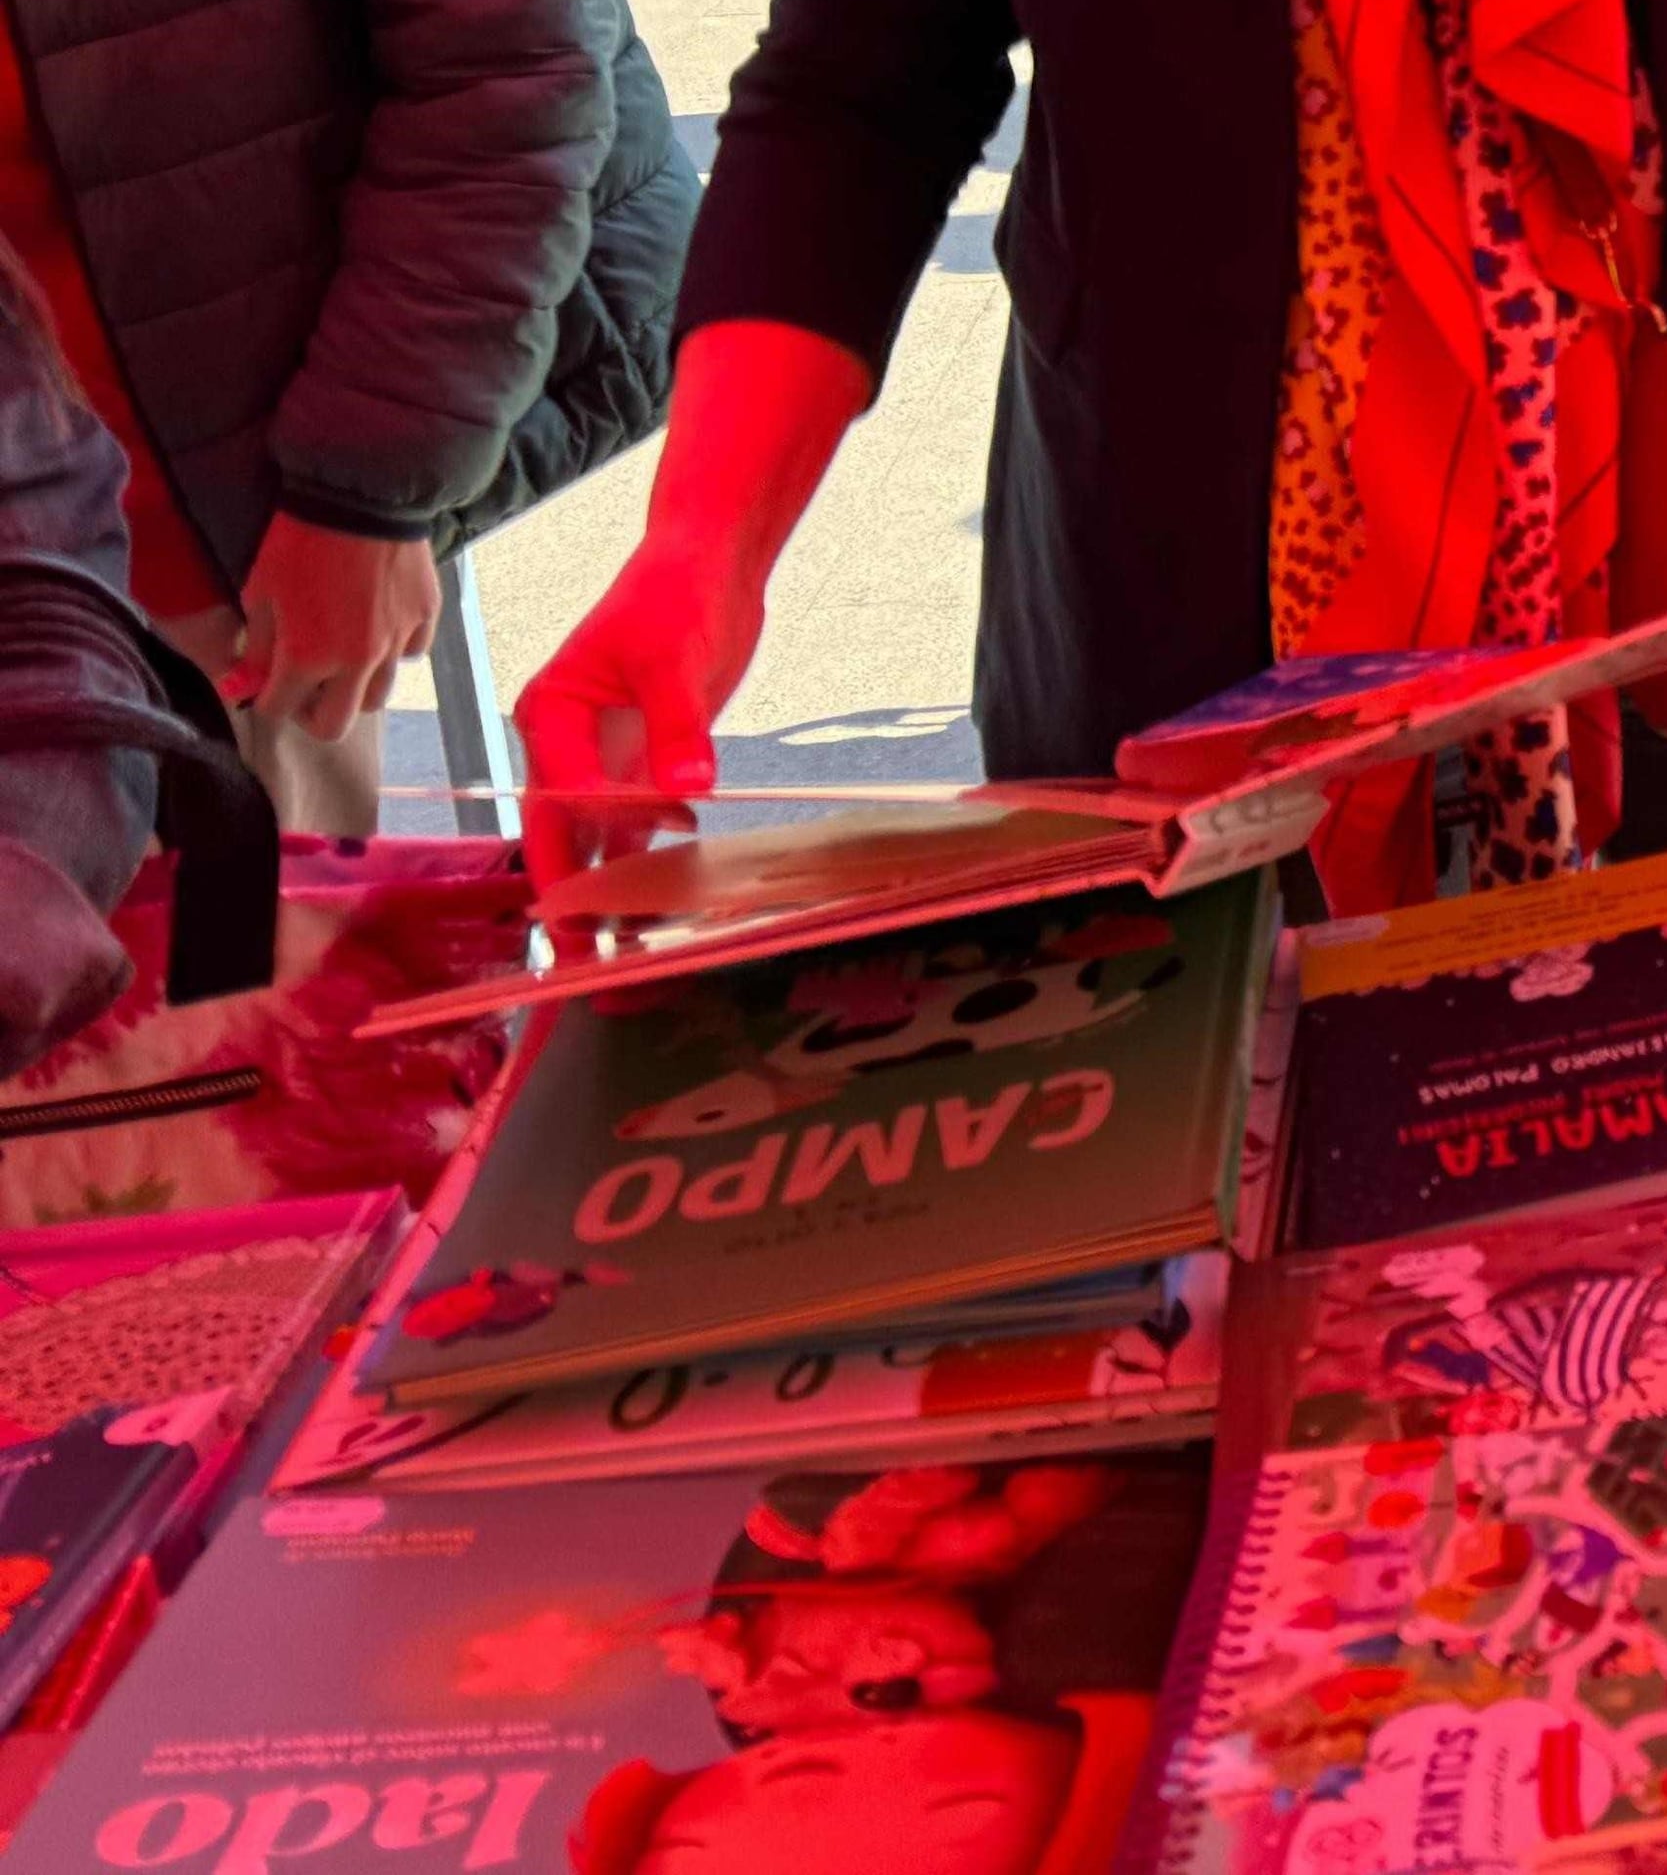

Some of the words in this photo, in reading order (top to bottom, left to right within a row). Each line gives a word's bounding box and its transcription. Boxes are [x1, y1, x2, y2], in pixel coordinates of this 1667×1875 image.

[1417, 1061, 1542, 1106] PALOMAS
[571, 1068, 1115, 1246] CAMPO
[93, 1768, 553, 1875] lado
